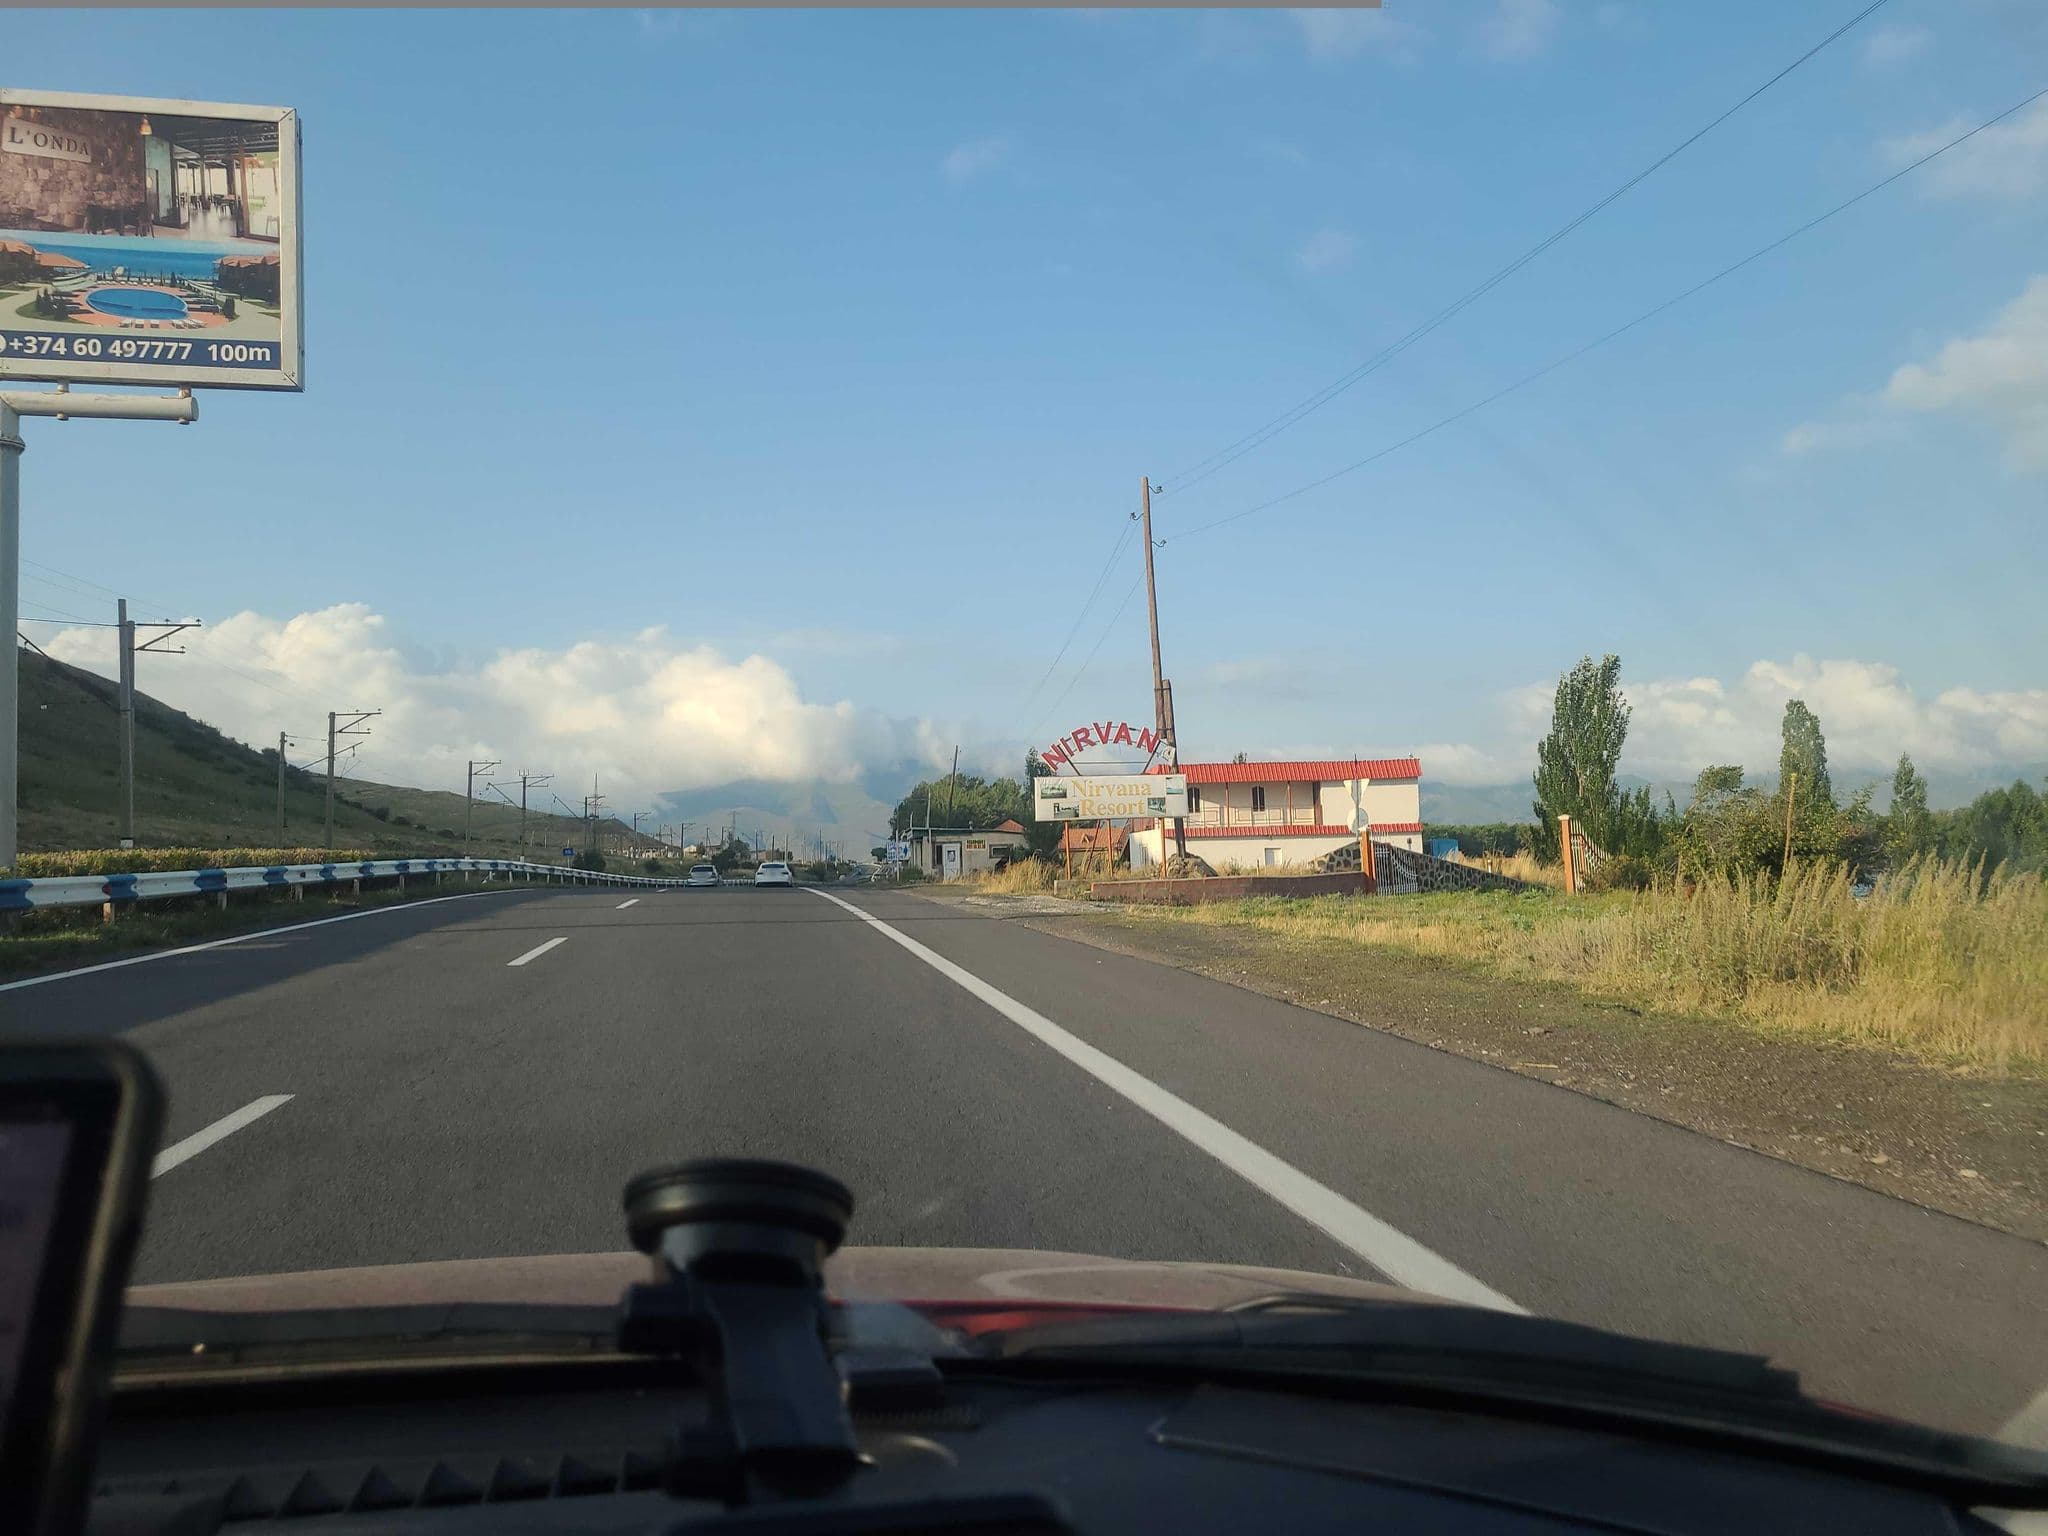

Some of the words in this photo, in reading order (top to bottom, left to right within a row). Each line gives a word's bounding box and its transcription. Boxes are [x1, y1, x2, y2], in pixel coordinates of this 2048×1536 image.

[8, 127, 90, 156] L'ONDA
[9, 335, 67, 355] +374
[73, 338, 102, 357] 60
[108, 339, 193, 360] 497777
[207, 344, 271, 362] 100m
[1041, 721, 1161, 772] NIRVAN
[1071, 779, 1152, 799] Nirvana
[1080, 799, 1145, 817] Resort
